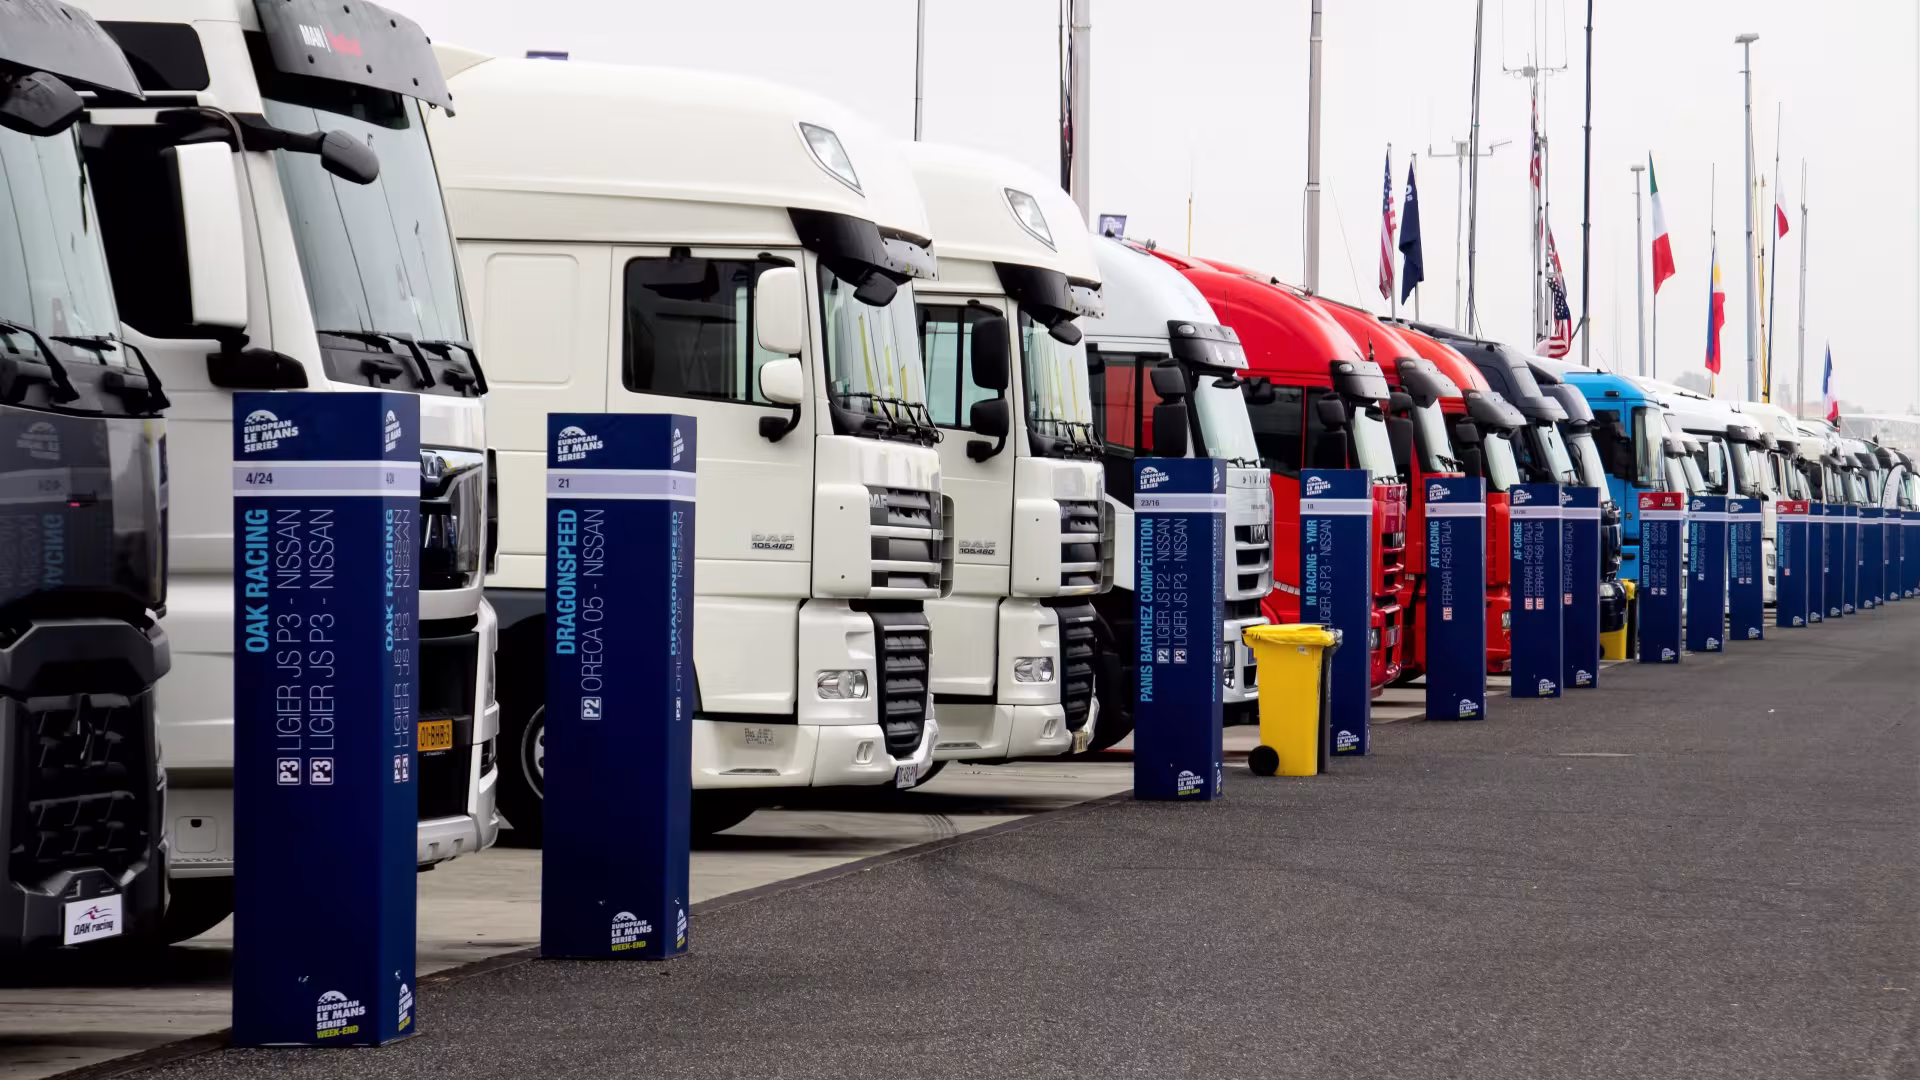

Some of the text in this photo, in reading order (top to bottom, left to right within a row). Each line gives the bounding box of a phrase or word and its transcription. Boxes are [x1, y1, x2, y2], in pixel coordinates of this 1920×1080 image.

[299, 24, 326, 48] MAN
[244, 420, 292, 434] EUROPEAN
[244, 426, 299, 444] LE MANS
[244, 440, 278, 453] SERIES
[558, 435, 597, 446] EUROPEAN
[558, 440, 603, 454] LE MANS
[558, 452, 586, 462] SERIES
[245, 472, 273, 484] 4/24
[558, 478, 570, 488] 21
[1150, 475, 1169, 483] MANS
[752, 533, 794, 542] DAF
[1157, 519, 1170, 561] NISSAN
[1174, 519, 1188, 561] NISSAN
[1306, 520, 1317, 543] YMR
[1320, 520, 1331, 556] NISSAN
[1442, 520, 1451, 545] ITALIA
[1514, 522, 1522, 548] CORSE
[276, 509, 302, 589] NISSAN
[309, 509, 334, 589] NISSAN
[583, 509, 605, 576] NISSAN
[959, 540, 996, 548] DAF
[1430, 521, 1440, 568] AT RACING
[1442, 546, 1452, 569] F458
[1514, 550, 1522, 560] AF
[245, 509, 269, 653] OAK RACING
[556, 509, 577, 654] DRAGONSPEED
[1157, 574, 1170, 589] P2
[1174, 574, 1188, 589] P3
[1306, 553, 1317, 593] RACING
[1320, 565, 1331, 579] P3
[1320, 581, 1331, 594] JS
[1442, 571, 1452, 605] FERRARI
[583, 597, 604, 622] 05
[1157, 593, 1170, 607] JS
[1174, 593, 1188, 607] JS
[1306, 595, 1317, 606] M
[276, 613, 302, 643] P3
[309, 613, 334, 643] P3
[386, 604, 394, 651] OAK
[1140, 605, 1153, 662] BARTHEZ
[1157, 611, 1170, 645] LIGIER
[1174, 611, 1188, 645] LIGIER
[276, 650, 302, 678] JS
[309, 650, 334, 678] JS
[581, 627, 603, 692] ORECA
[1158, 650, 1169, 662] P2
[1175, 650, 1186, 662] P3
[1140, 666, 1153, 702] PANIS
[276, 685, 302, 750] LIGIER
[309, 685, 334, 750] LIGIER
[583, 699, 599, 718] P2
[279, 760, 299, 782] P3
[312, 760, 332, 782] P3
[1186, 778, 1204, 786] MANS
[73, 919, 114, 935] OAK racing
[611, 925, 652, 937] LE MANS
[612, 920, 647, 930] EUROPEAN
[611, 935, 637, 944] SERIES
[612, 941, 646, 952] WEEK-END
[317, 1000, 359, 1012] EUROPEAN
[317, 1006, 366, 1022] LE MANS
[317, 1018, 347, 1030] SERIES
[317, 1025, 359, 1039] WEEK-END
